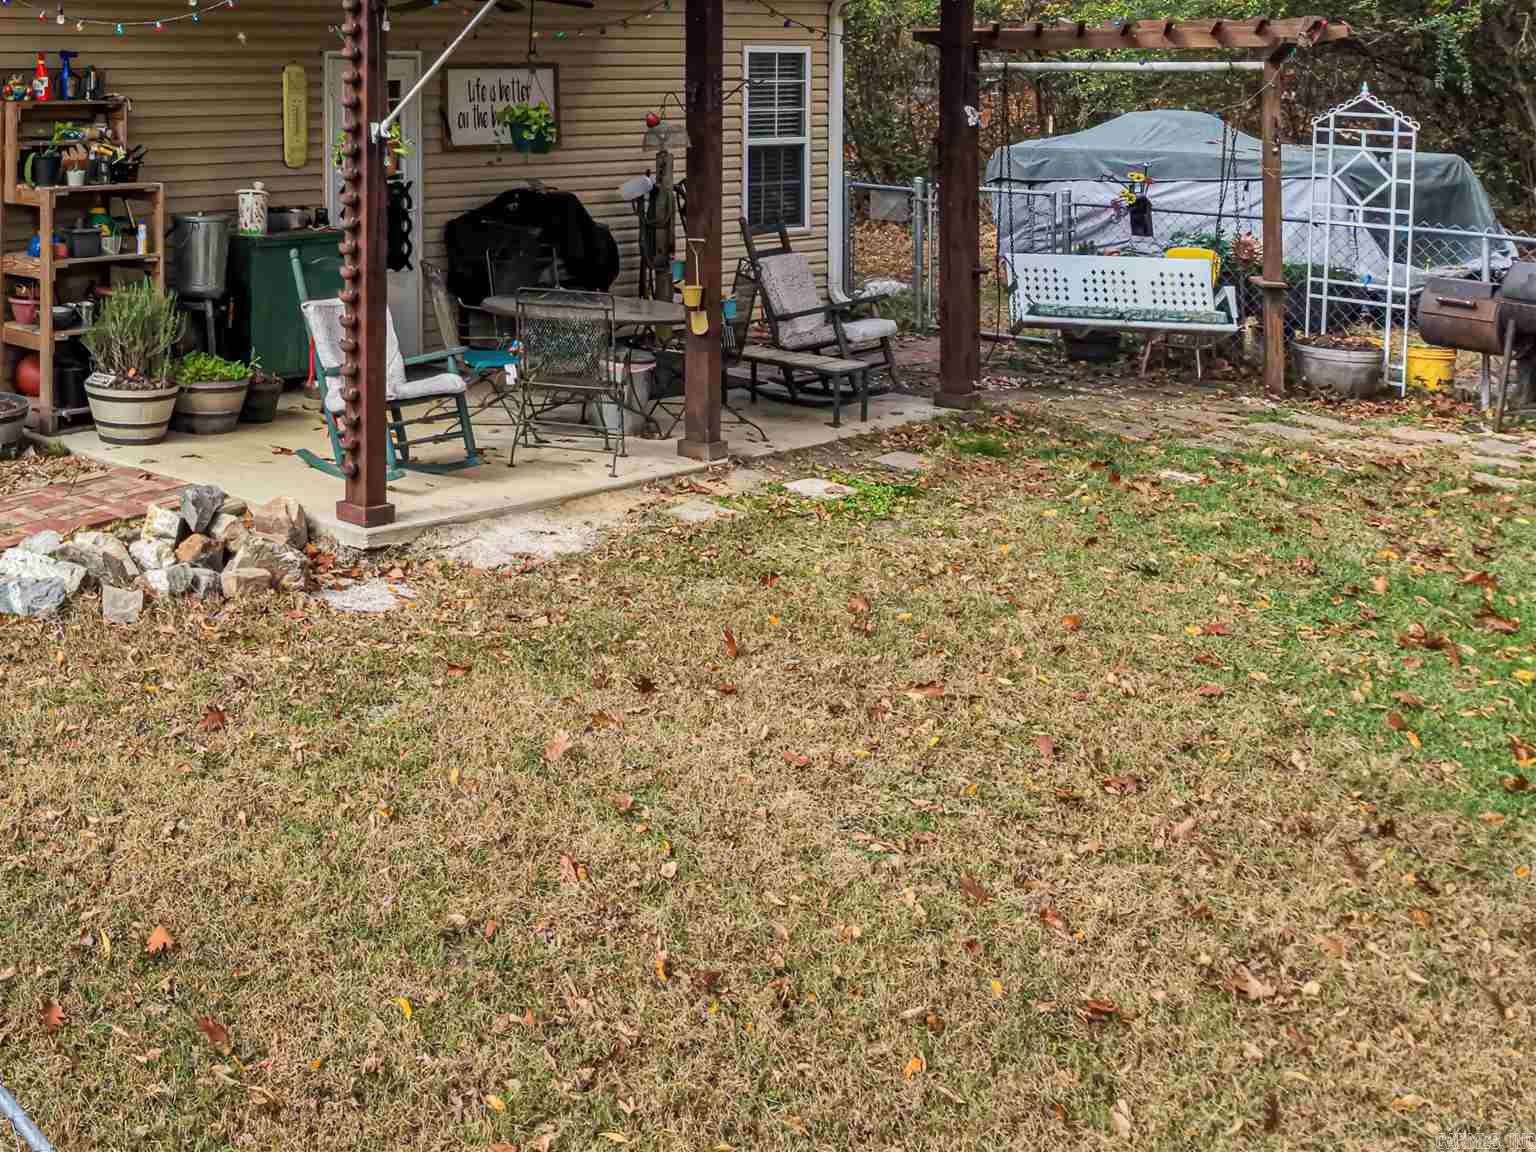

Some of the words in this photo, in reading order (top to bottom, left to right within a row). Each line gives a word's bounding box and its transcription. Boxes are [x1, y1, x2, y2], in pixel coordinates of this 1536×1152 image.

[498, 76, 531, 103] better
[457, 110, 469, 129] on
[472, 104, 488, 130] the
